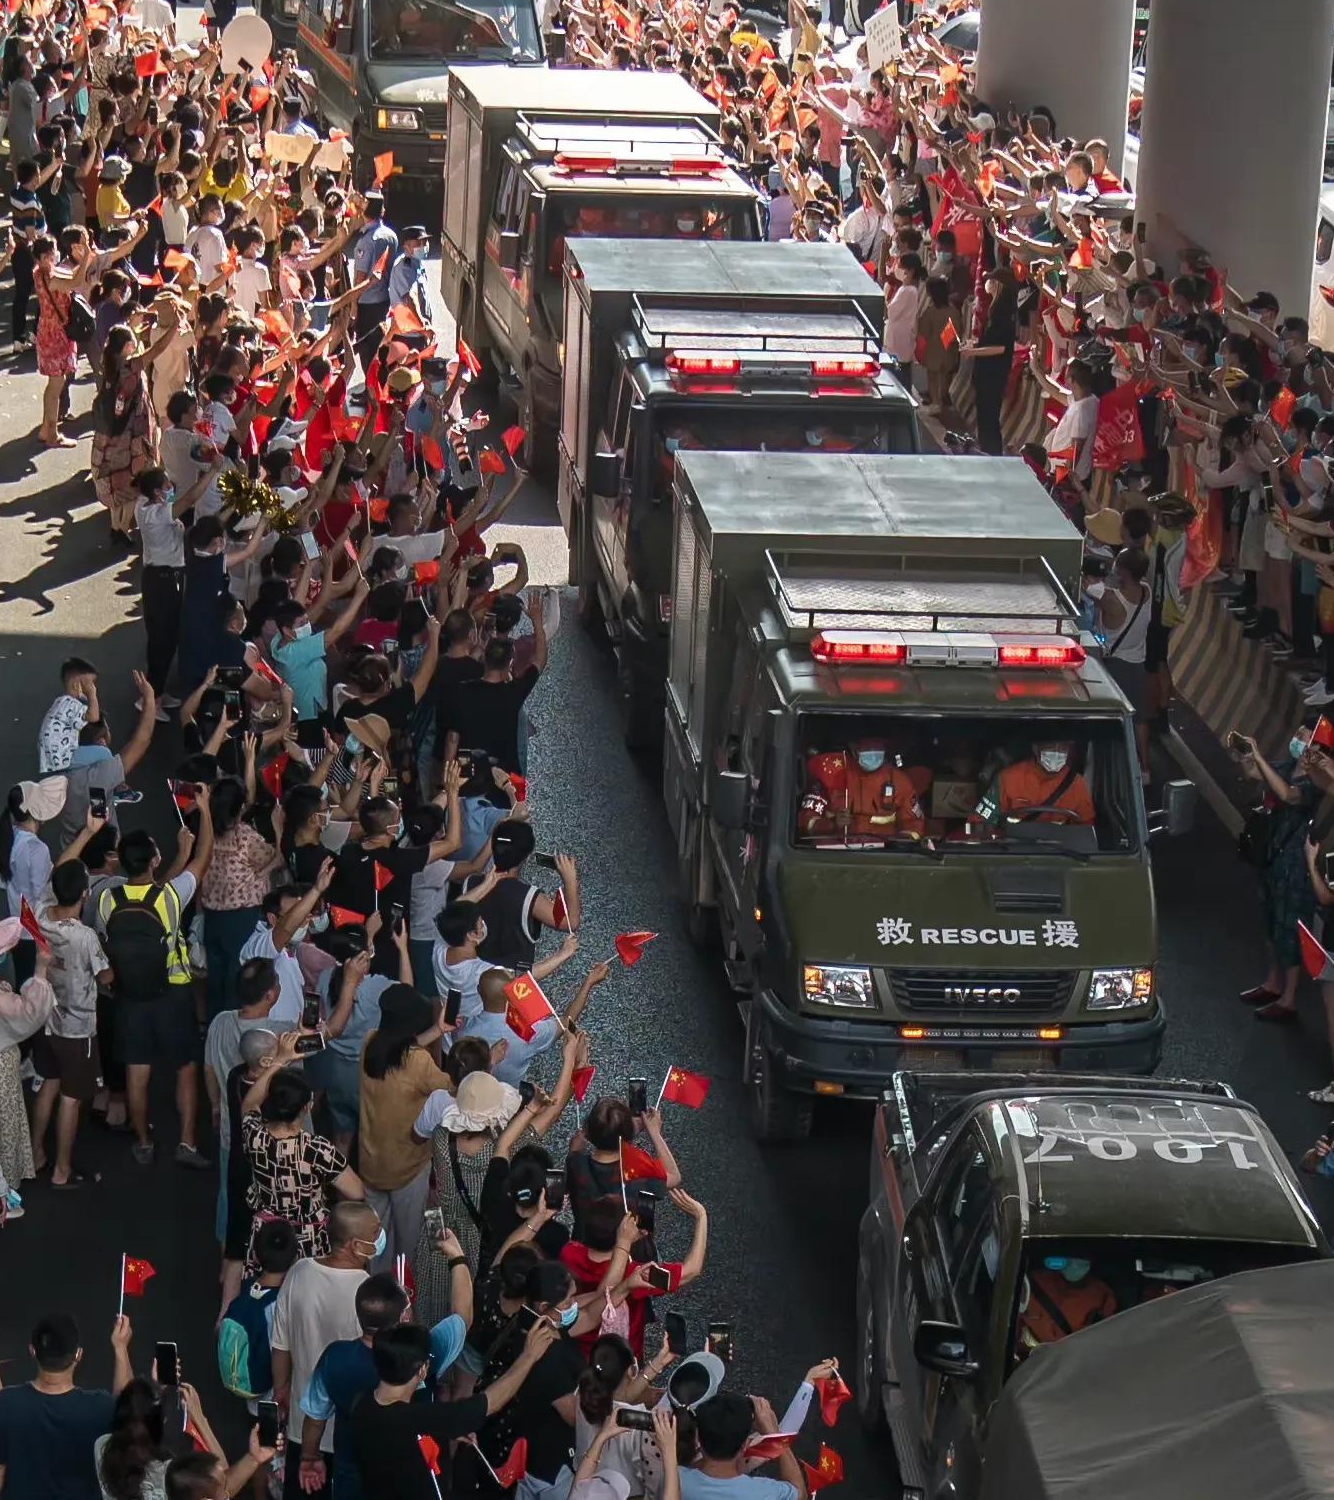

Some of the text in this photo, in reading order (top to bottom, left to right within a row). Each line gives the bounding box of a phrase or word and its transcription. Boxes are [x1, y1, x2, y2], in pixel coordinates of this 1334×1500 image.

[876, 917, 1080, 948] 救 RESCUE 援
[944, 987, 1021, 1003] IVECO
